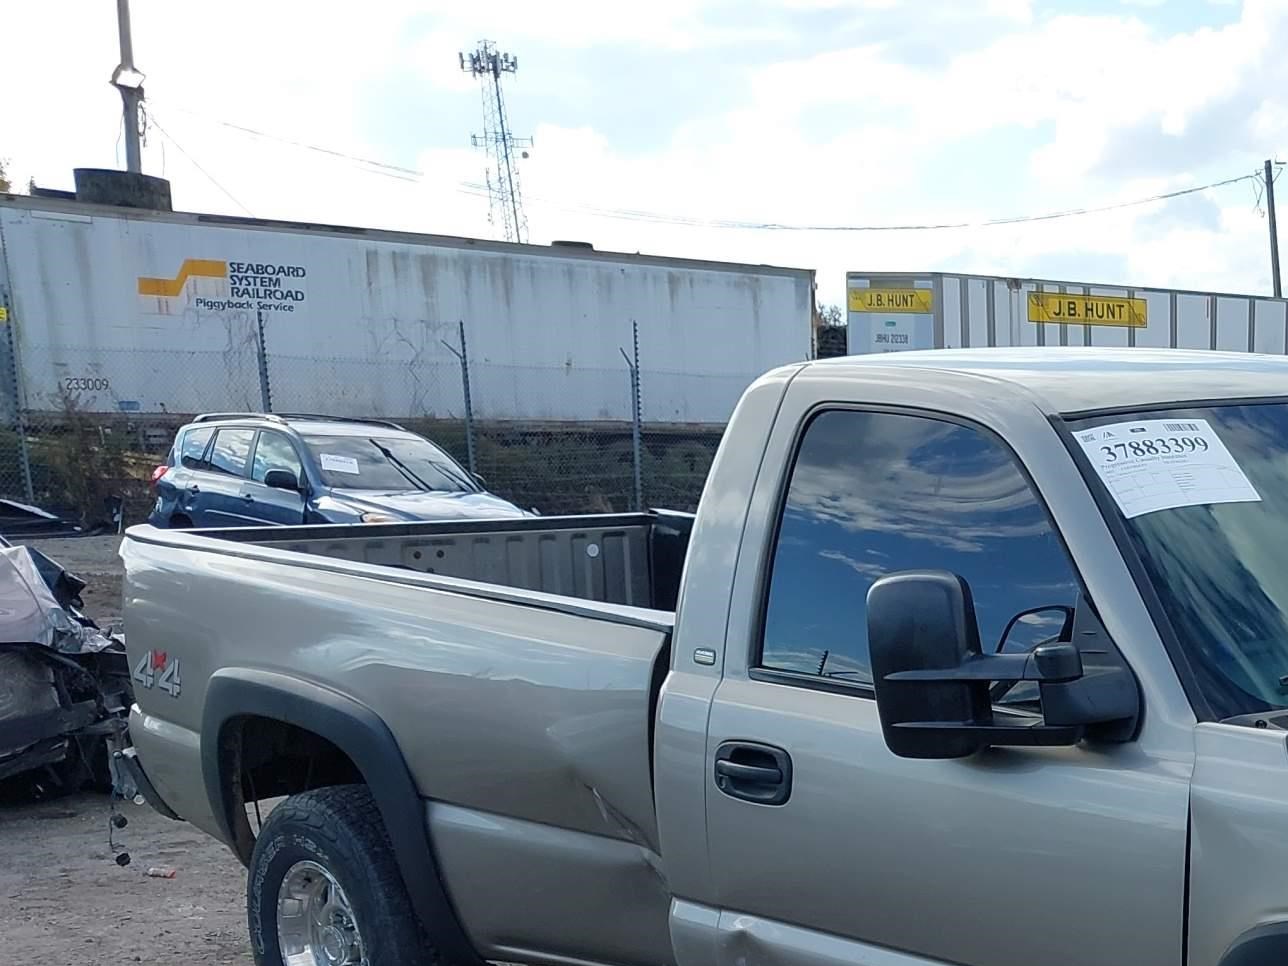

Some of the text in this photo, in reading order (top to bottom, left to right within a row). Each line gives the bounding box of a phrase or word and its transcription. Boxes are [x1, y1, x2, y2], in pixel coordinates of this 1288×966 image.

[228, 262, 306, 278] SEABOARD
[229, 275, 281, 288] SYSTEM
[230, 286, 305, 301] RAILROAD
[867, 294, 915, 307] J.B. HUNT
[195, 298, 295, 312] Piggyback Service
[1053, 300, 1125, 320] J.B. HUNT
[65, 377, 110, 391] 233009
[1100, 436, 1209, 462] 37883399
